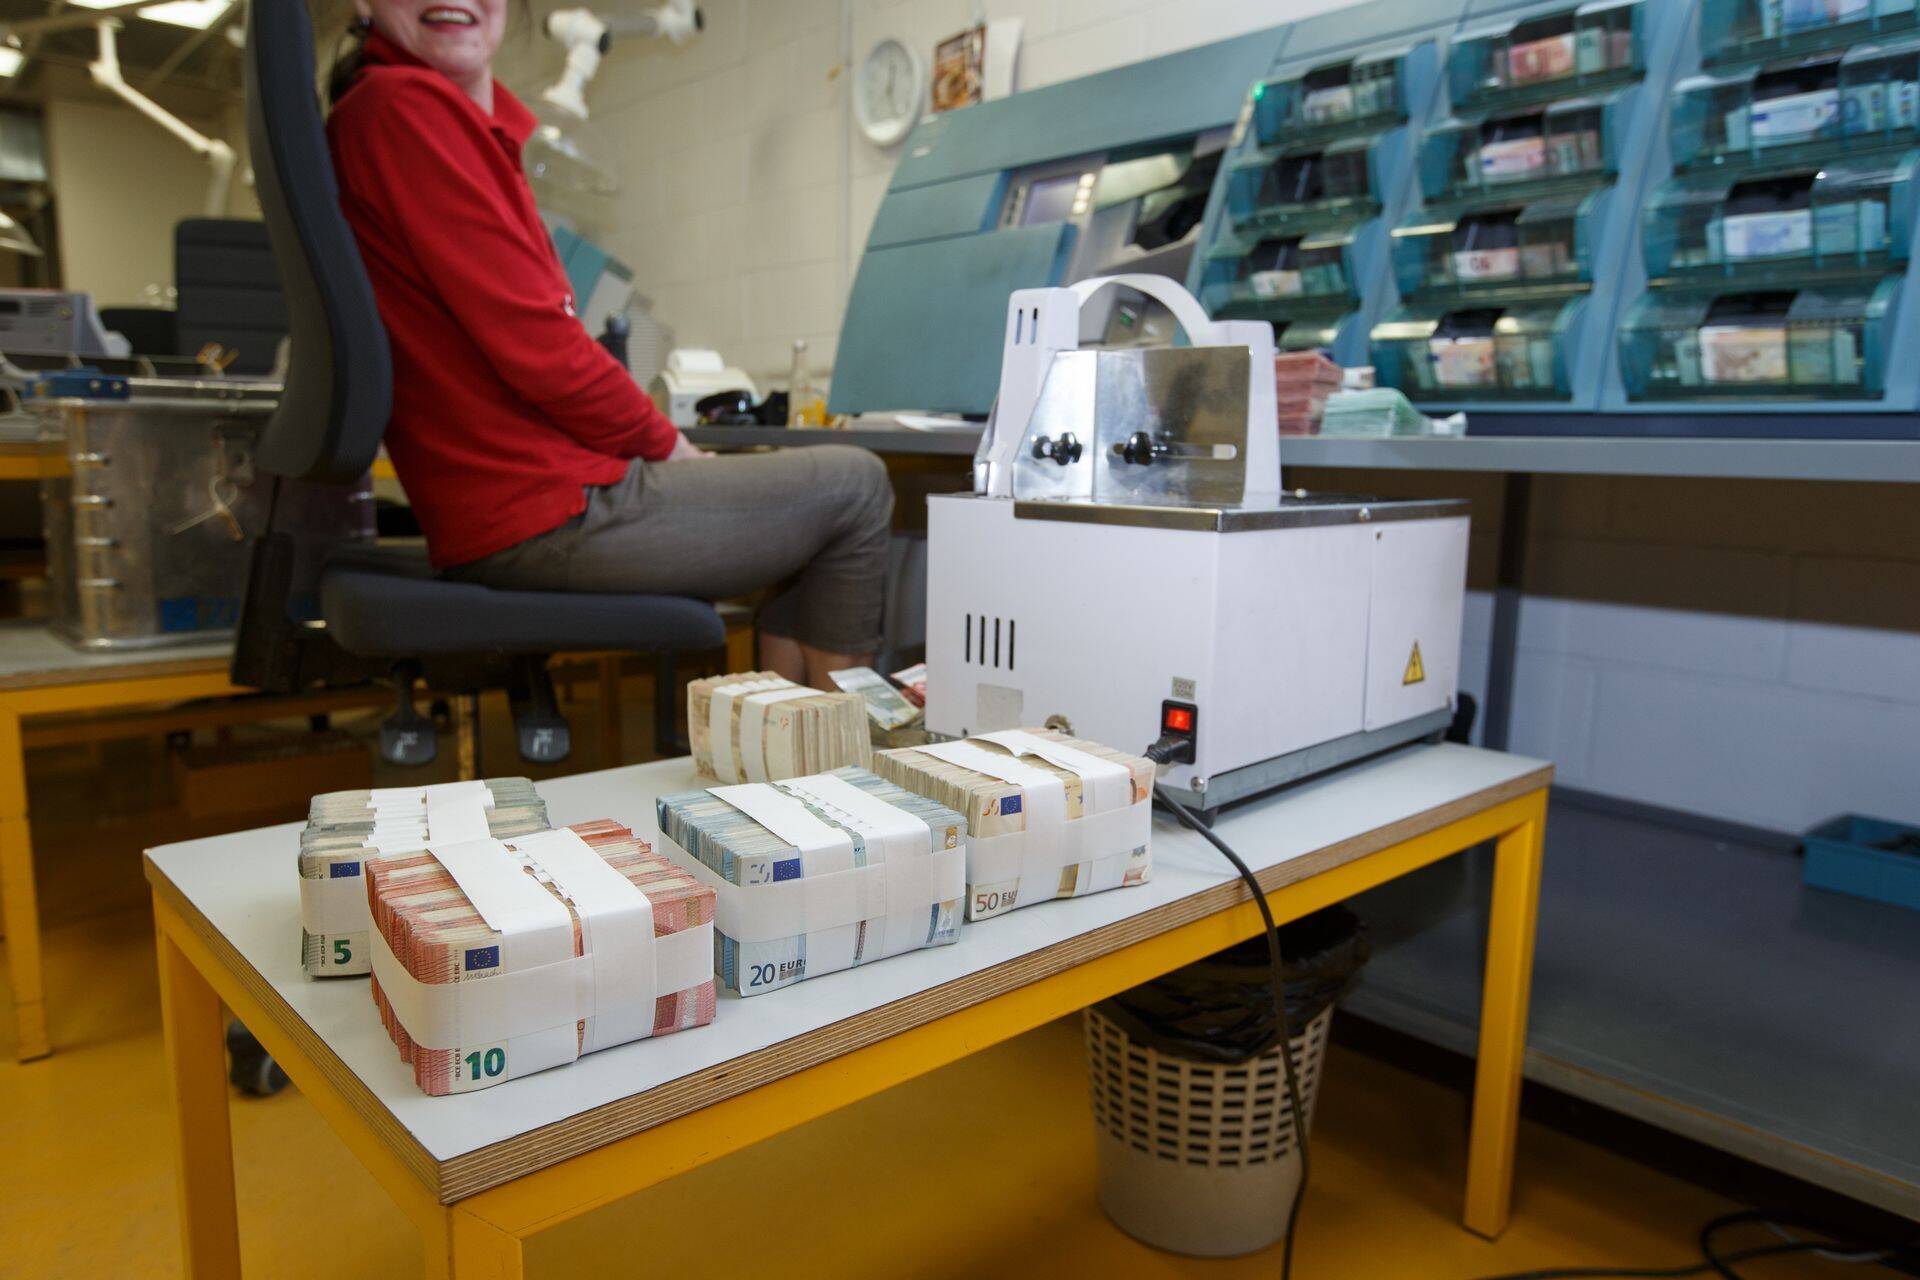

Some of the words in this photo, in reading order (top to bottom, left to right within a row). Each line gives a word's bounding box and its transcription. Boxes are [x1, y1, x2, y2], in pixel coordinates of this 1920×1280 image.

[976, 892, 999, 913] 50
[1001, 888, 1018, 901] EU
[333, 939, 352, 965] 5
[749, 963, 776, 987] 20
[780, 959, 806, 972] EUR
[464, 1047, 506, 1081] 10
